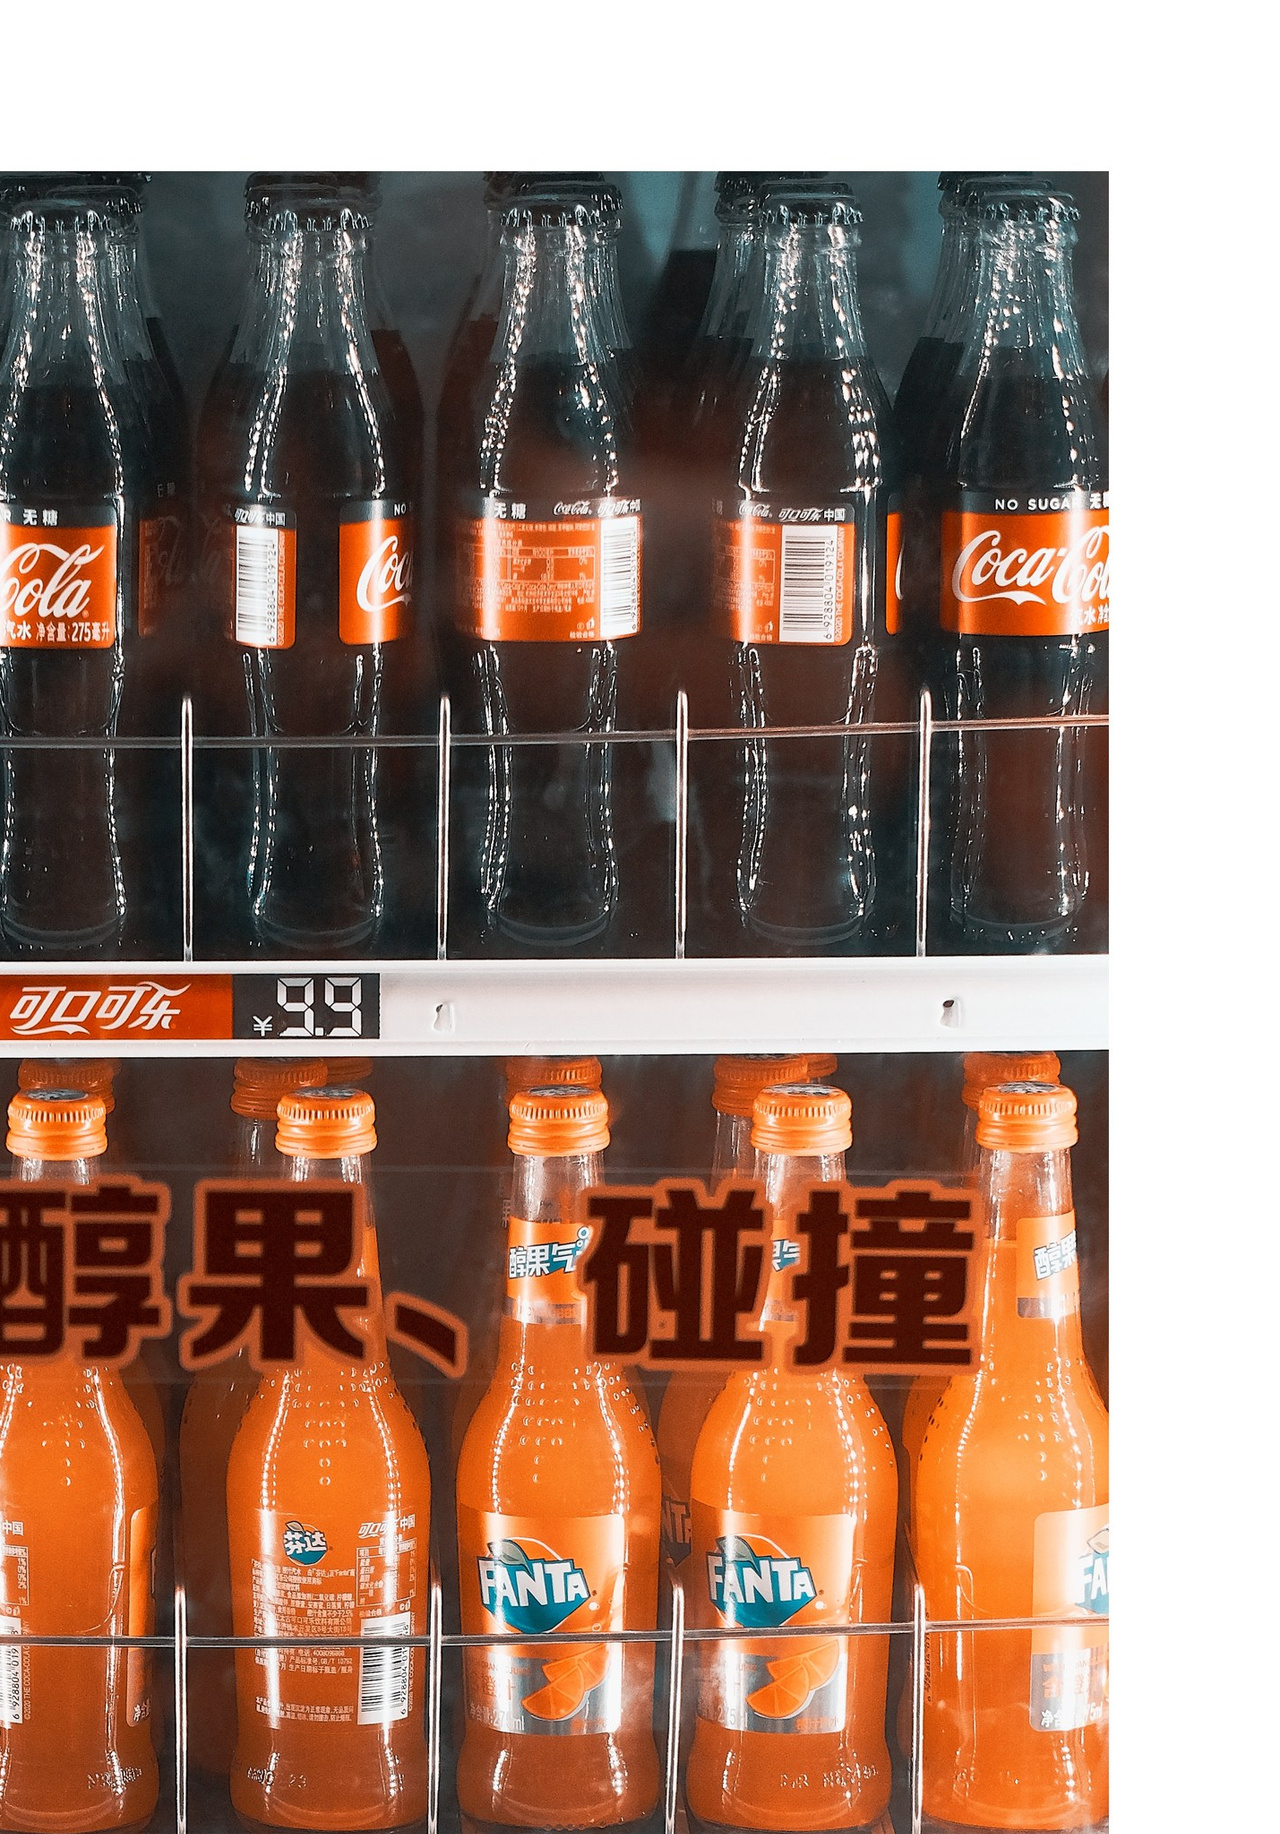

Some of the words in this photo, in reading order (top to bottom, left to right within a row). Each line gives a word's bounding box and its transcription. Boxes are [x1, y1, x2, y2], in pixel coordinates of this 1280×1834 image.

[22, 508, 59, 527] 无糖
[995, 498, 1019, 511] NO
[825, 540, 834, 582] 019124
[823, 586, 833, 628] 928804
[9, 981, 191, 1036] 可口可乐
[508, 1227, 591, 1280] 醇果气
[283, 1530, 327, 1556] 芬达
[358, 1513, 416, 1539] 可口可中国
[477, 1558, 590, 1605] FANTA
[707, 1556, 816, 1604] FANTA
[24, 1650, 32, 1686] COCA-COLA
[400, 1665, 409, 1702] 928804
[11, 1671, 20, 1707] 928804
[24, 1687, 32, 1699] THE
